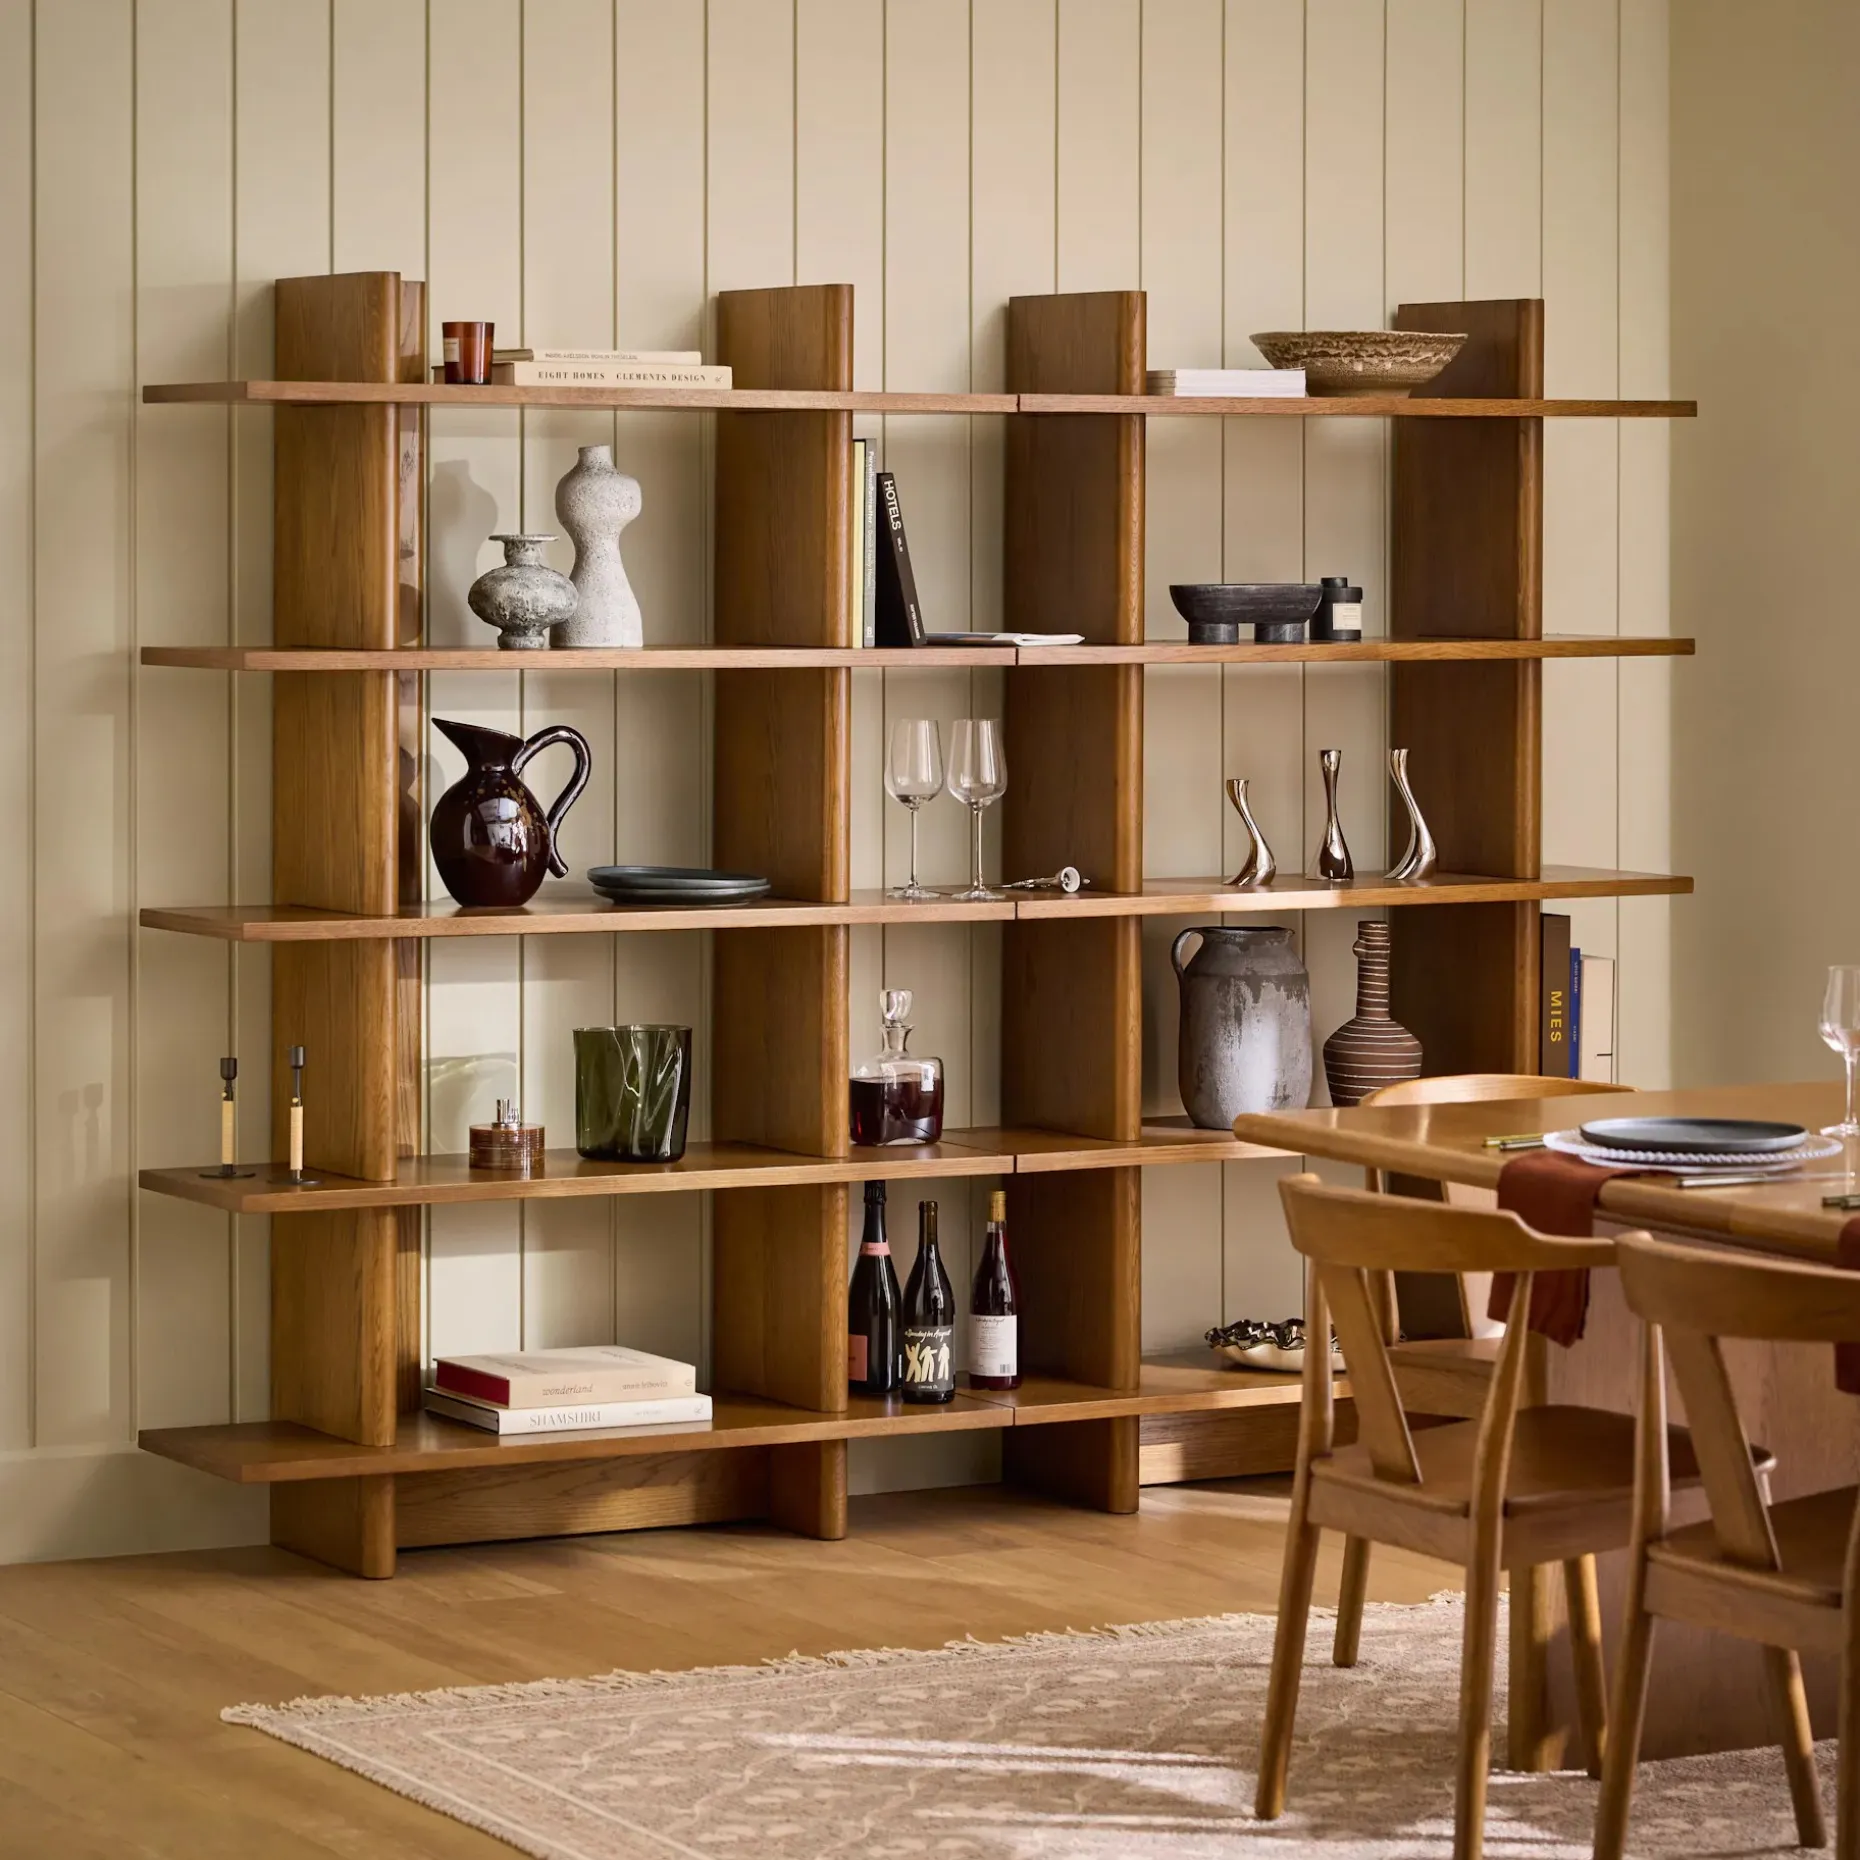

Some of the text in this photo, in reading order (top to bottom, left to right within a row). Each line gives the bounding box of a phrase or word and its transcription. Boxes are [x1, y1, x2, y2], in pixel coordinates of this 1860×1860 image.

[538, 371, 605, 380] EIGHT HOMES
[616, 372, 707, 382] CLEMENTS DESIGN
[883, 479, 902, 531] HOTELS
[1550, 990, 1563, 1043] MIES
[542, 1383, 593, 1396] wonderland
[529, 1410, 602, 1427] SHAMSHIRI
